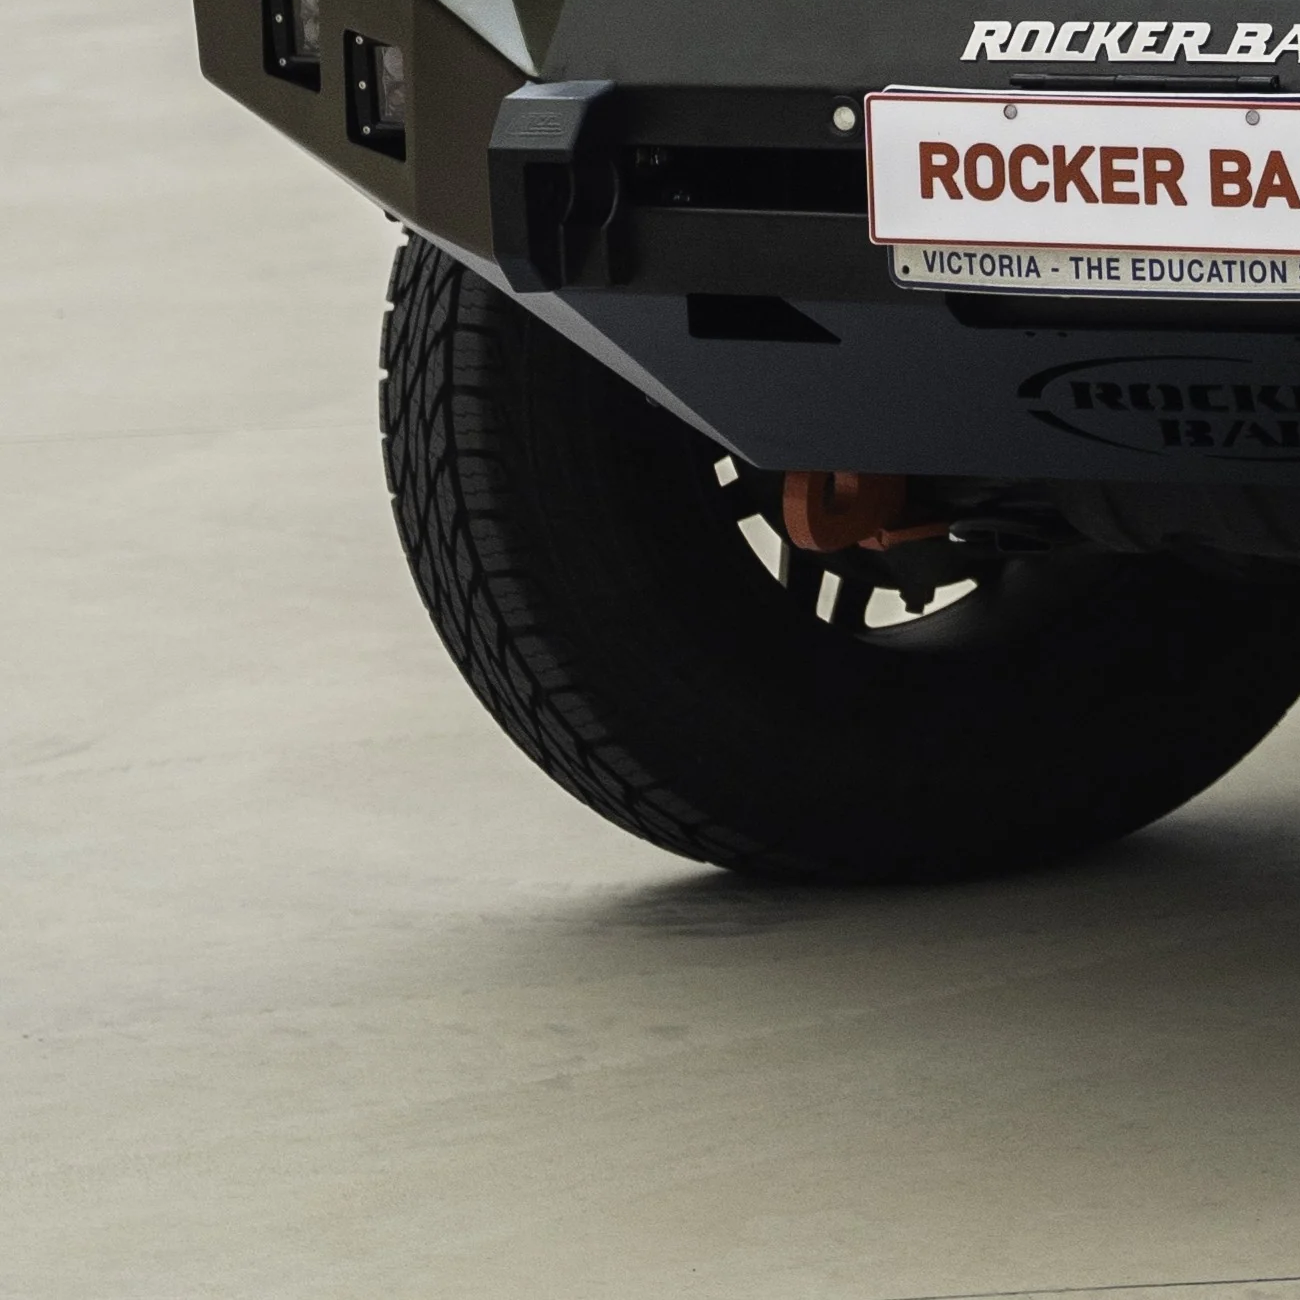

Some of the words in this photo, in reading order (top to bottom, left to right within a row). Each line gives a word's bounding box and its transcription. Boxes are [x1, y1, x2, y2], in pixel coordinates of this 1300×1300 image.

[960, 20, 1212, 62] ROCKER
[919, 141, 1188, 206] ROCKER
[922, 250, 1041, 279] VICTORIA
[1069, 256, 1121, 281] THE
[1131, 257, 1288, 284] EDUCATION
